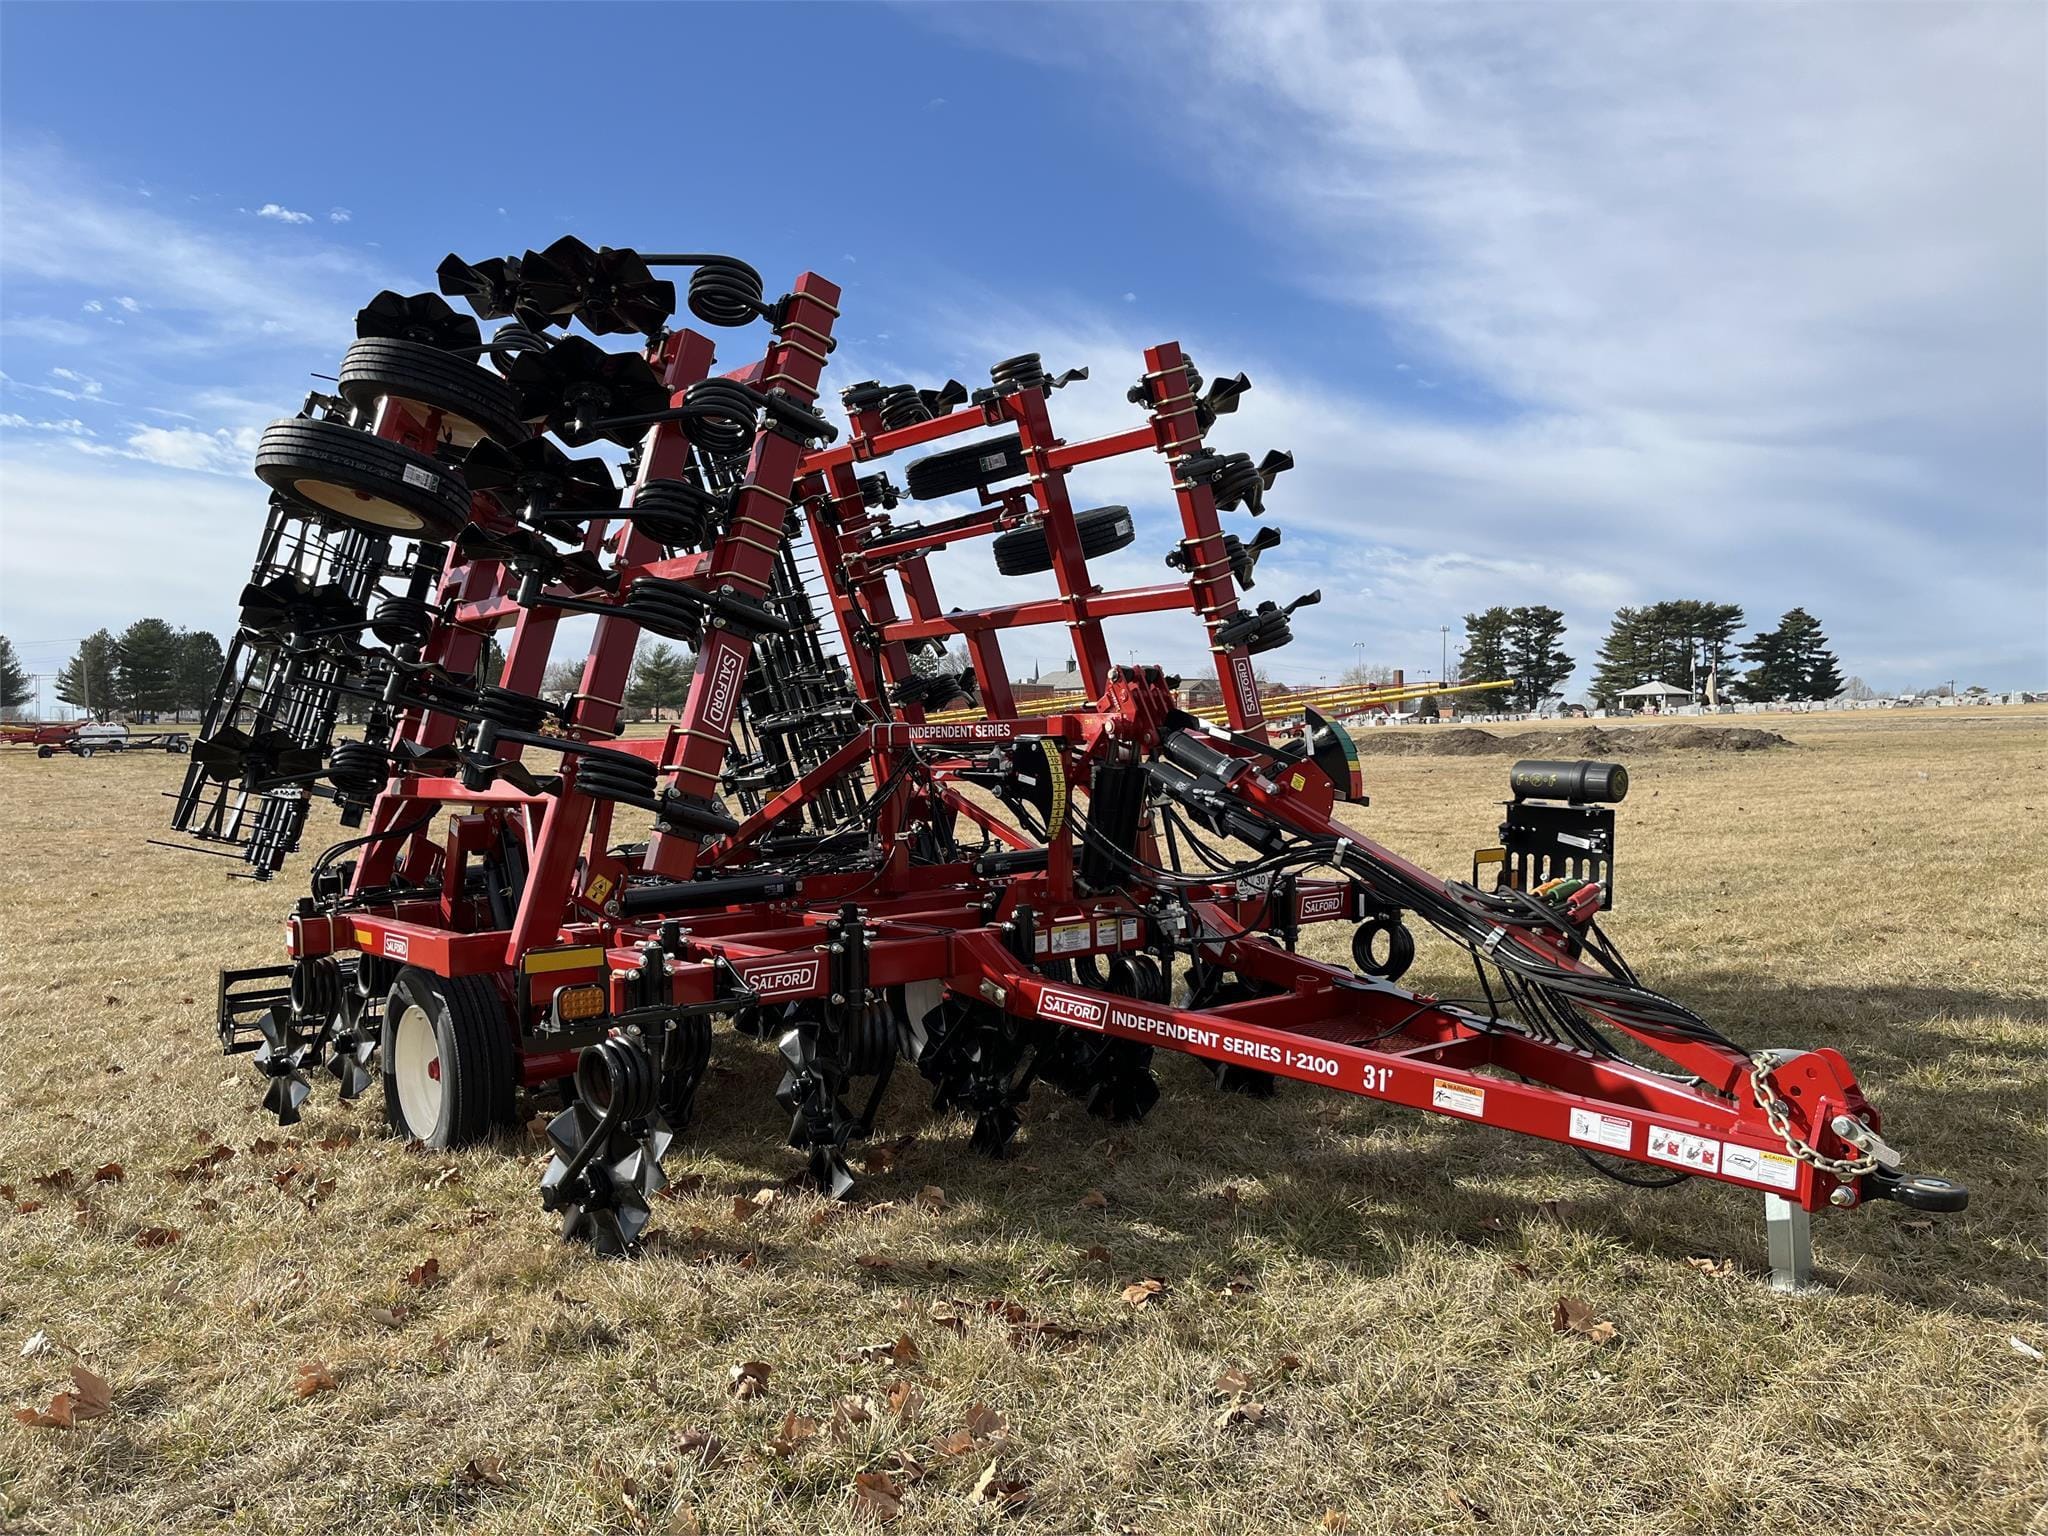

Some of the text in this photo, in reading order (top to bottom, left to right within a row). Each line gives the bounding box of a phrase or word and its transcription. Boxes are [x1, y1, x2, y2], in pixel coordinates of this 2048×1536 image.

[710, 654, 737, 722] SALFORD
[1237, 662, 1256, 712] SALFORD
[908, 724, 1011, 739] INDEPENDENT SERIES
[1255, 875, 1266, 886] 30
[1304, 897, 1340, 914] SALFORD
[749, 968, 811, 991] SALFORD
[1043, 995, 1393, 1092] SALFORD INDEPENDENT SERIES I-2100 31'
[1768, 1154, 1792, 1164] CAUTION
